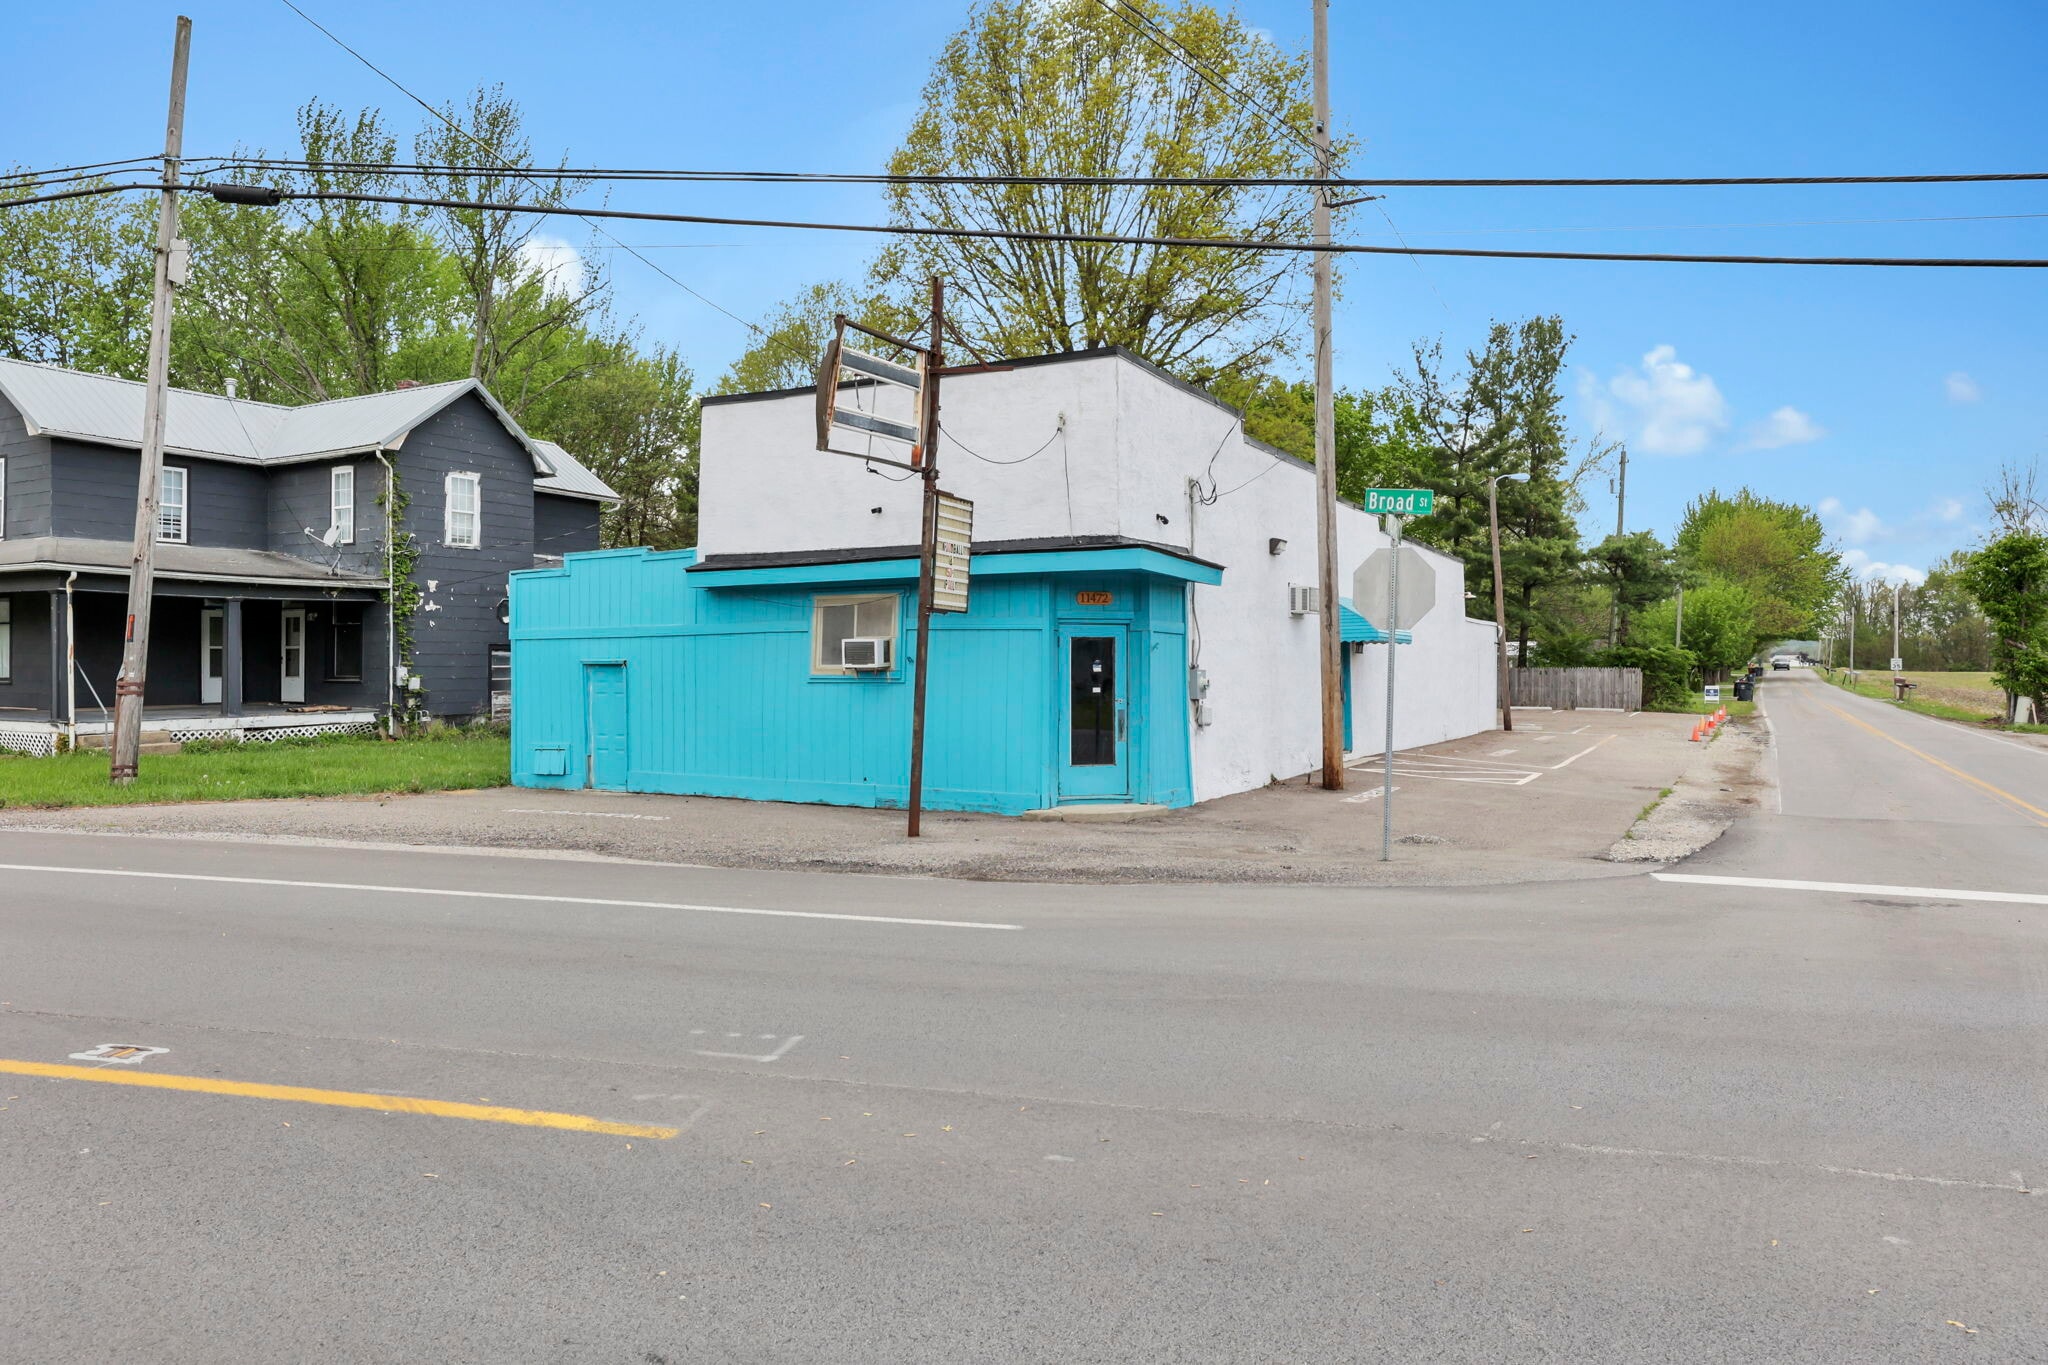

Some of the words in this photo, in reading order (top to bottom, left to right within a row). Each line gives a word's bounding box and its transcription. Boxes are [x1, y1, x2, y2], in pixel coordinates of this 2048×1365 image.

[1369, 492, 1414, 510] Broad
[1419, 497, 1428, 507] St
[1080, 592, 1109, 603] 11472
